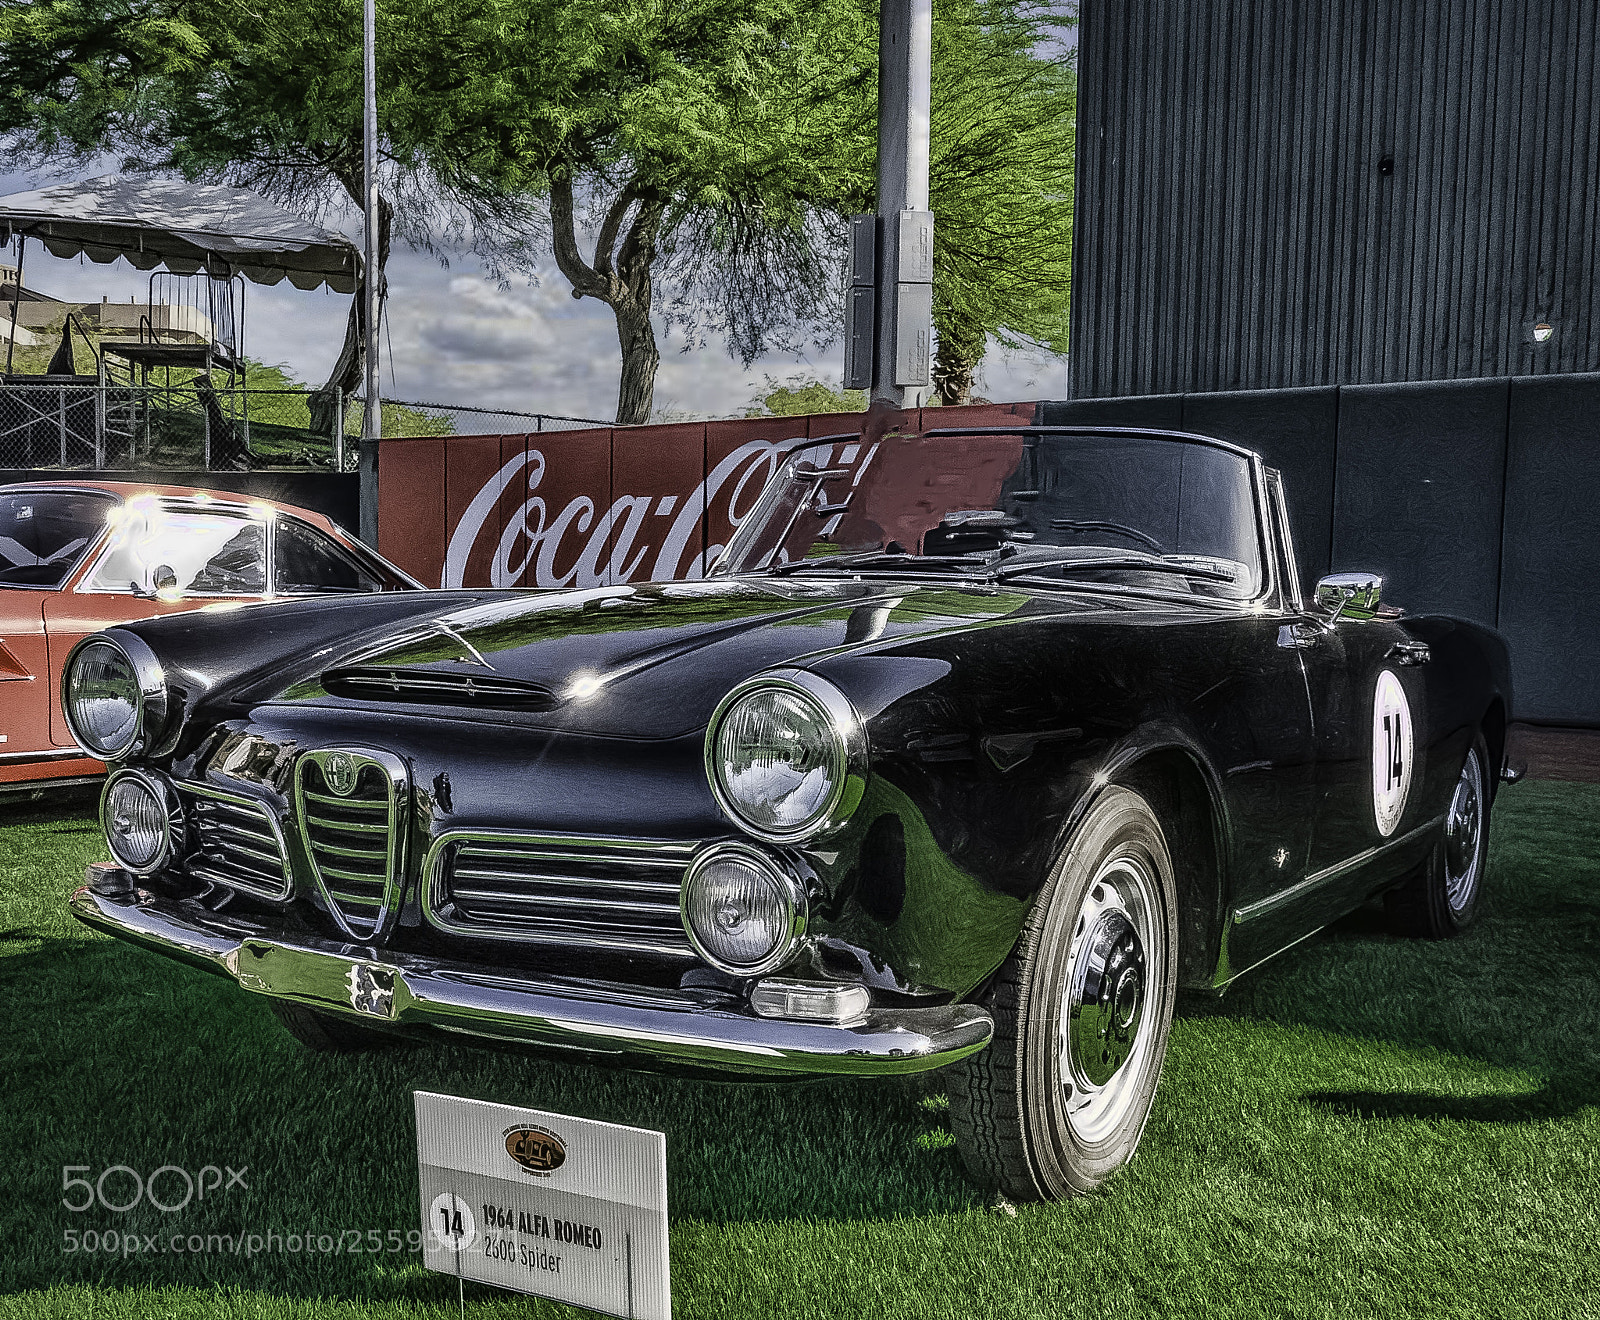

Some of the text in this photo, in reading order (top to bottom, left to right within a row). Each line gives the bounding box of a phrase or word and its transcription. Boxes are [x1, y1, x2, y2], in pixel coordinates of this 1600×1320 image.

[1384, 712, 1403, 791] 14
[440, 1208, 465, 1236] 14
[482, 1204, 602, 1250] 1964 ALFA ROMEO
[484, 1235, 562, 1274] 2600 Spider
